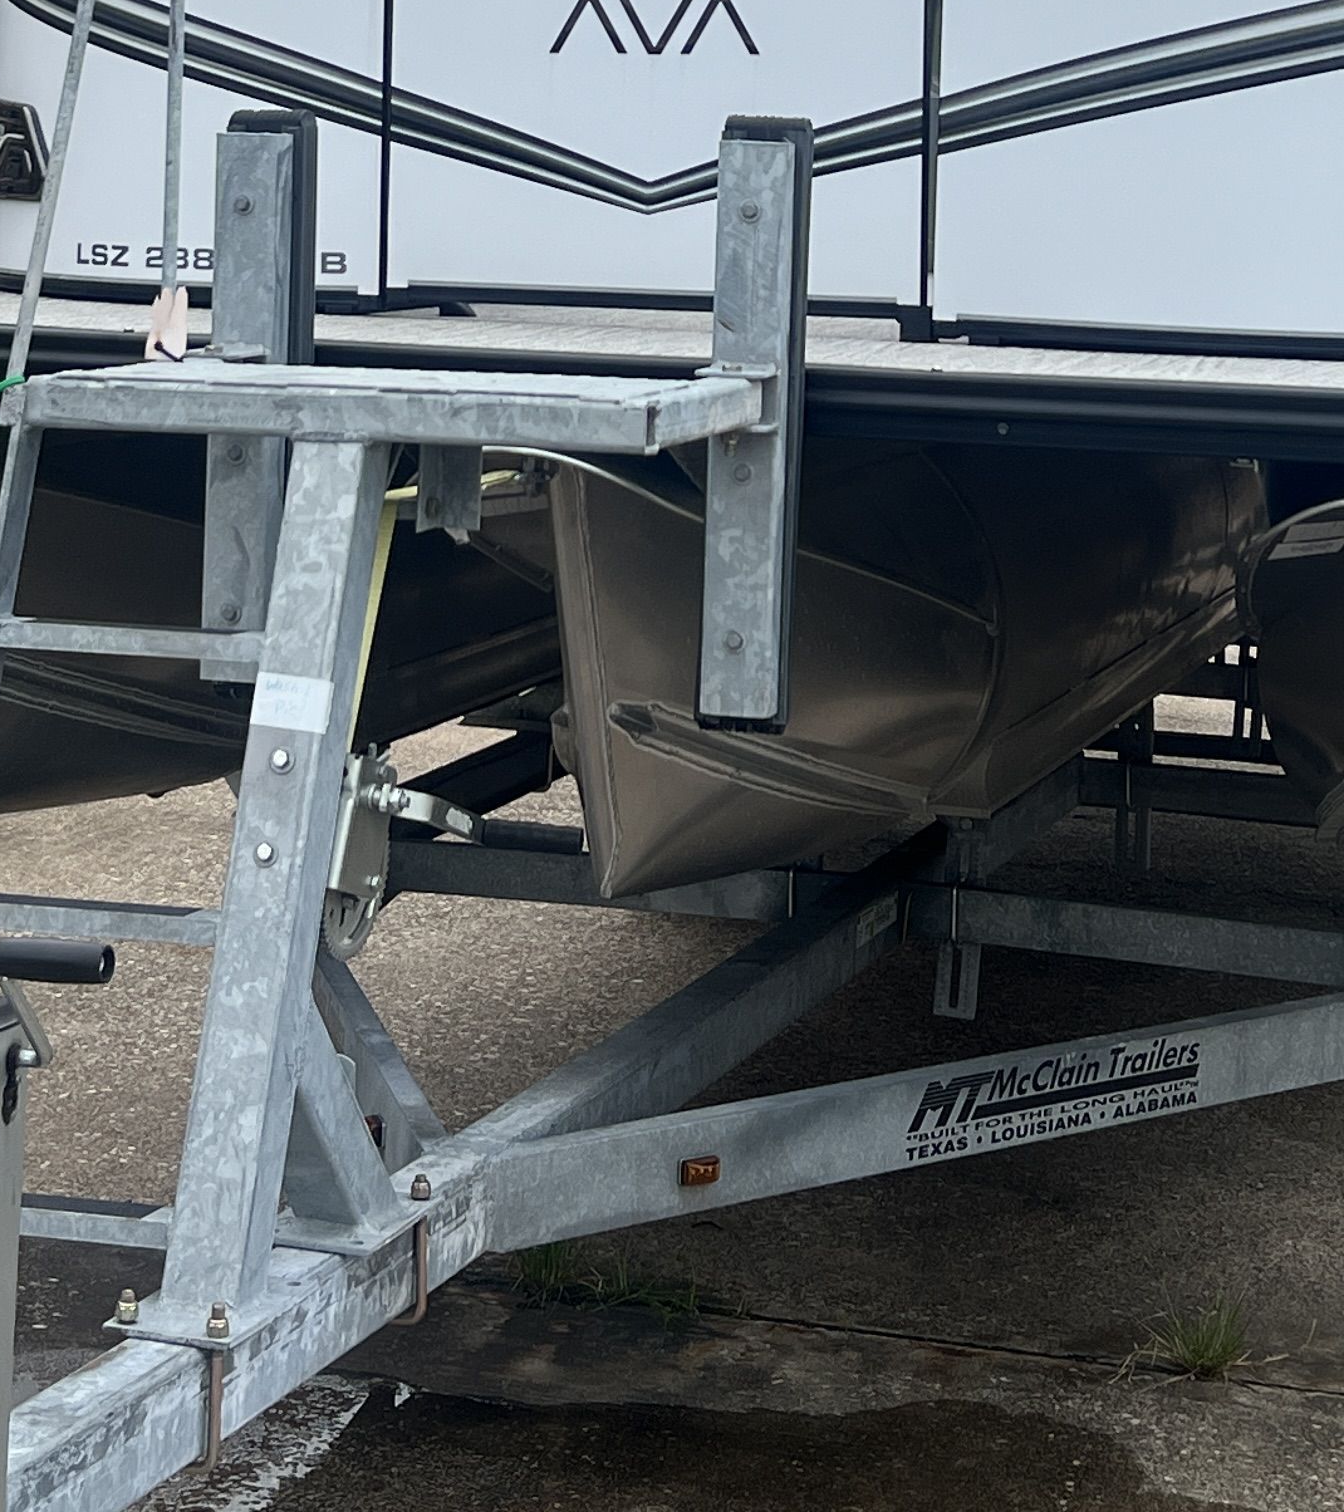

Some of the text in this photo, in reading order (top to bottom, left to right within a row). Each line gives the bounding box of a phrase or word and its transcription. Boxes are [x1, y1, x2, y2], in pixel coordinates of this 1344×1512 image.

[76, 242, 130, 268] LSZ
[987, 1053, 1100, 1101] McClain
[1108, 1038, 1200, 1079] Trailers
[906, 1091, 1197, 1161] TEXAS LOUISIANA ALABAMA
[975, 1114, 1013, 1132] FOR
[1018, 1106, 1053, 1125] THE
[1060, 1094, 1126, 1115] LONG
